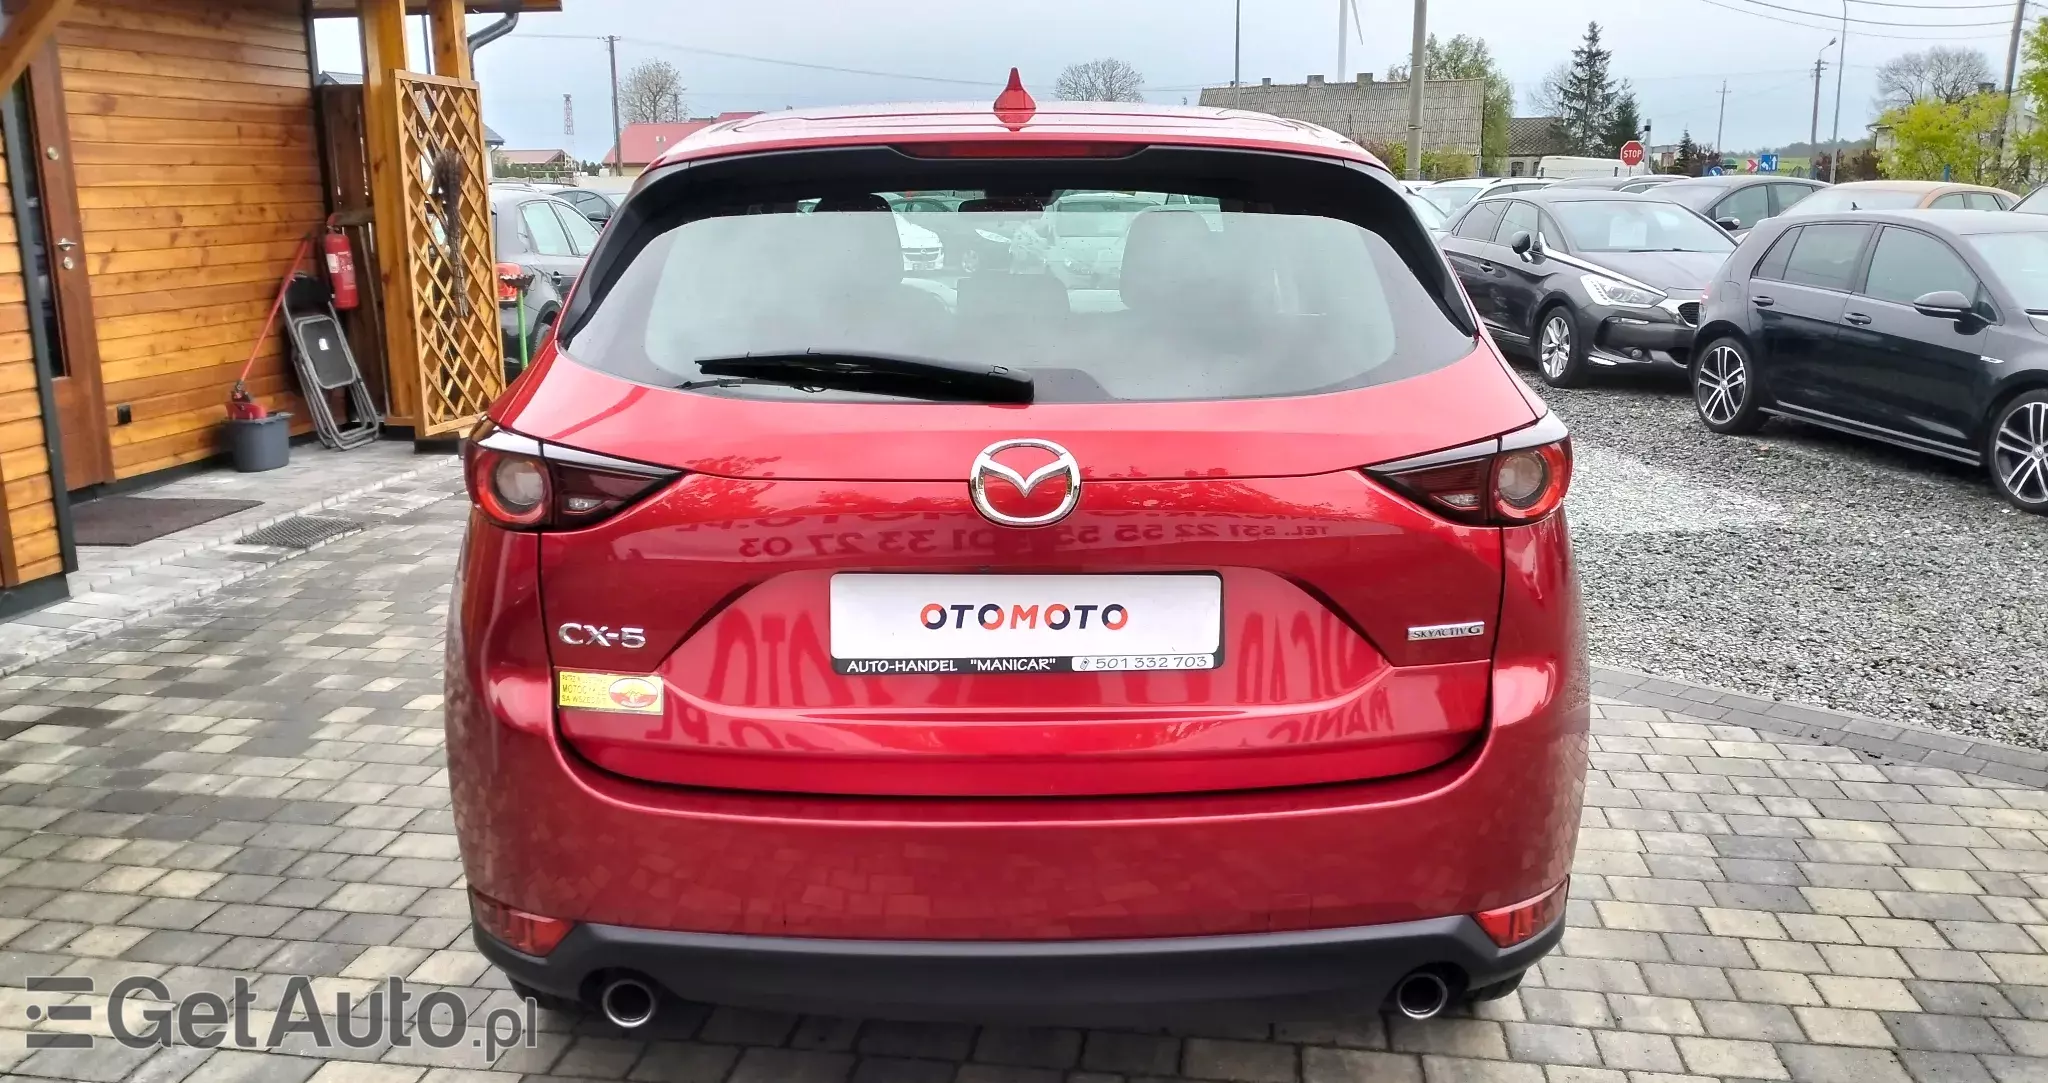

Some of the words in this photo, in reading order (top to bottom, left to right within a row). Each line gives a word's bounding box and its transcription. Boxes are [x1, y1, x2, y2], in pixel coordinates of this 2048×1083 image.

[1623, 149, 1642, 159] STOP
[920, 603, 1129, 631] OTOMOTO
[558, 622, 646, 649] CX-5
[846, 658, 958, 673] AUTO-HANDEL
[970, 657, 1056, 672] "MANICAR"
[1095, 657, 1128, 669] 501
[1134, 656, 1169, 669] 332
[1173, 655, 1208, 668] 703
